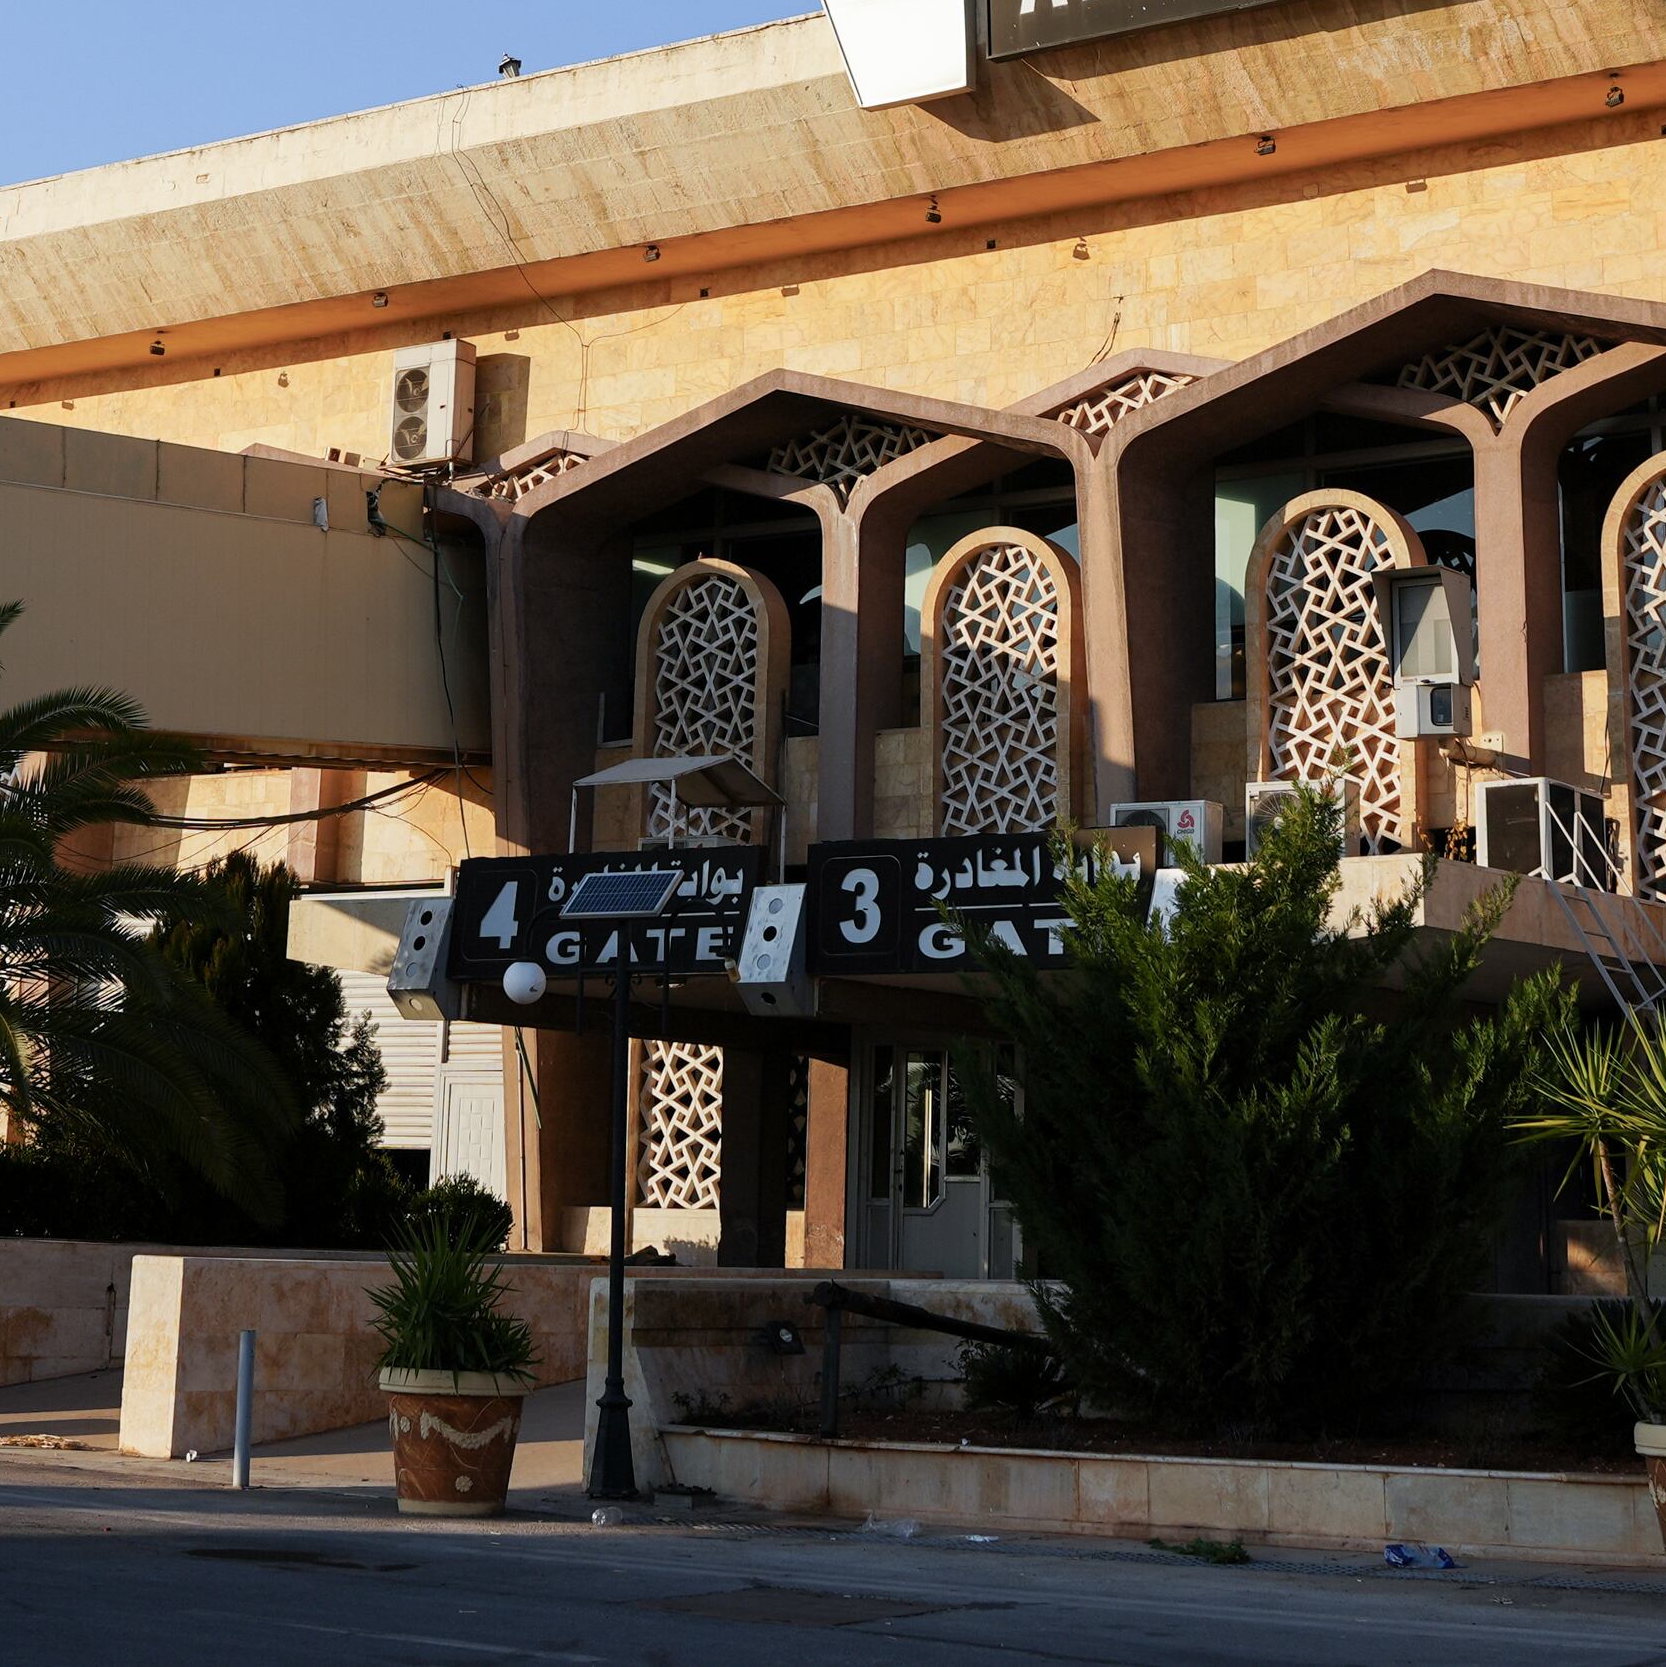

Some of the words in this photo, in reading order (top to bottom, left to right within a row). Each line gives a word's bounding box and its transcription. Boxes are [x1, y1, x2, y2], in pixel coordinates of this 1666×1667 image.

[914, 845, 1041, 901] المغادرة
[478, 880, 519, 950] 4
[840, 867, 882, 944] 3
[545, 925, 734, 965] GATE
[917, 918, 1080, 960] GAT
